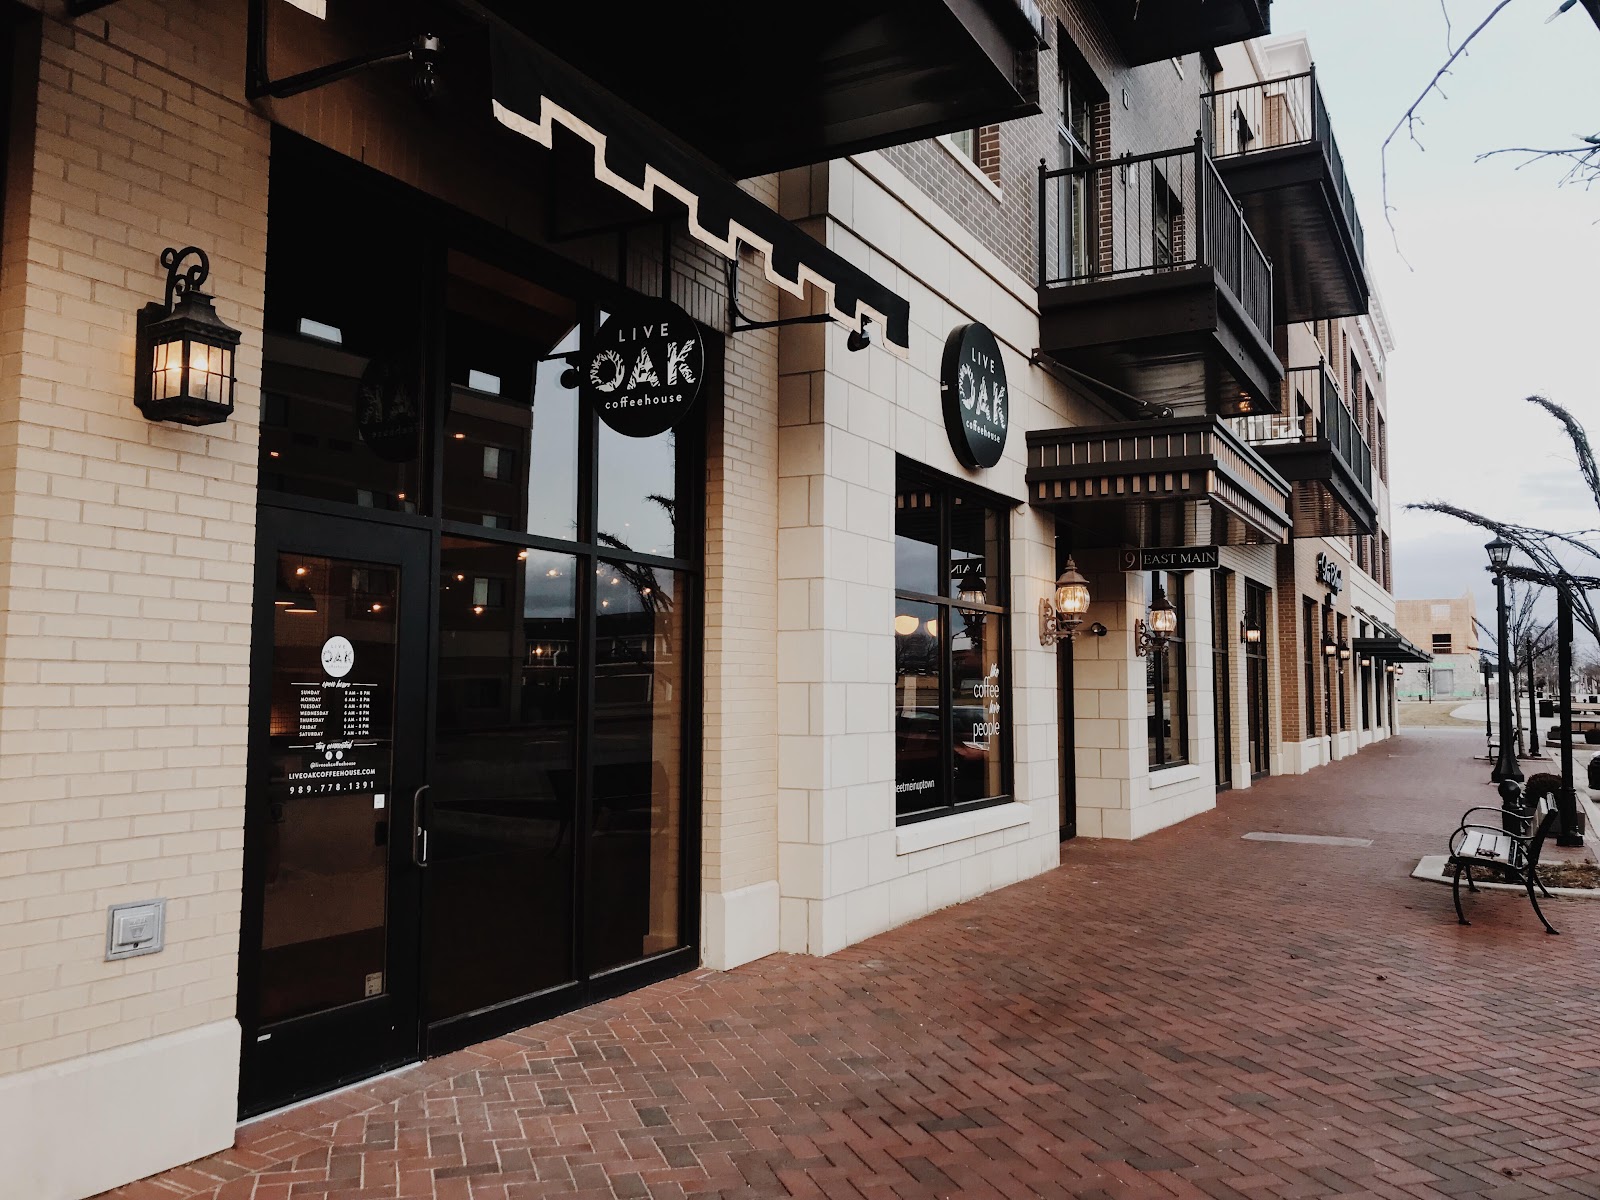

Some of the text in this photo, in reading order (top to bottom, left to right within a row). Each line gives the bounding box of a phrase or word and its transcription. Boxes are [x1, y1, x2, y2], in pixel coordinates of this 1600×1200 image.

[619, 323, 669, 342] LIVE
[589, 339, 696, 392] OAK
[971, 347, 995, 374] LIVE
[605, 394, 682, 409] coffeehouse
[958, 362, 1006, 429] OAK
[965, 419, 1001, 443] coffeehouse
[1125, 551, 1217, 569] 9 EAST MAIN
[323, 650, 352, 663] OAK
[974, 676, 1000, 698] coffee
[973, 713, 1000, 744] people
[289, 768, 376, 779] LIVEOAKCOFFEEHOUSE.COM
[310, 761, 356, 769] @liveoakcoffeehouse
[289, 781, 374, 794] 989.778.1391
